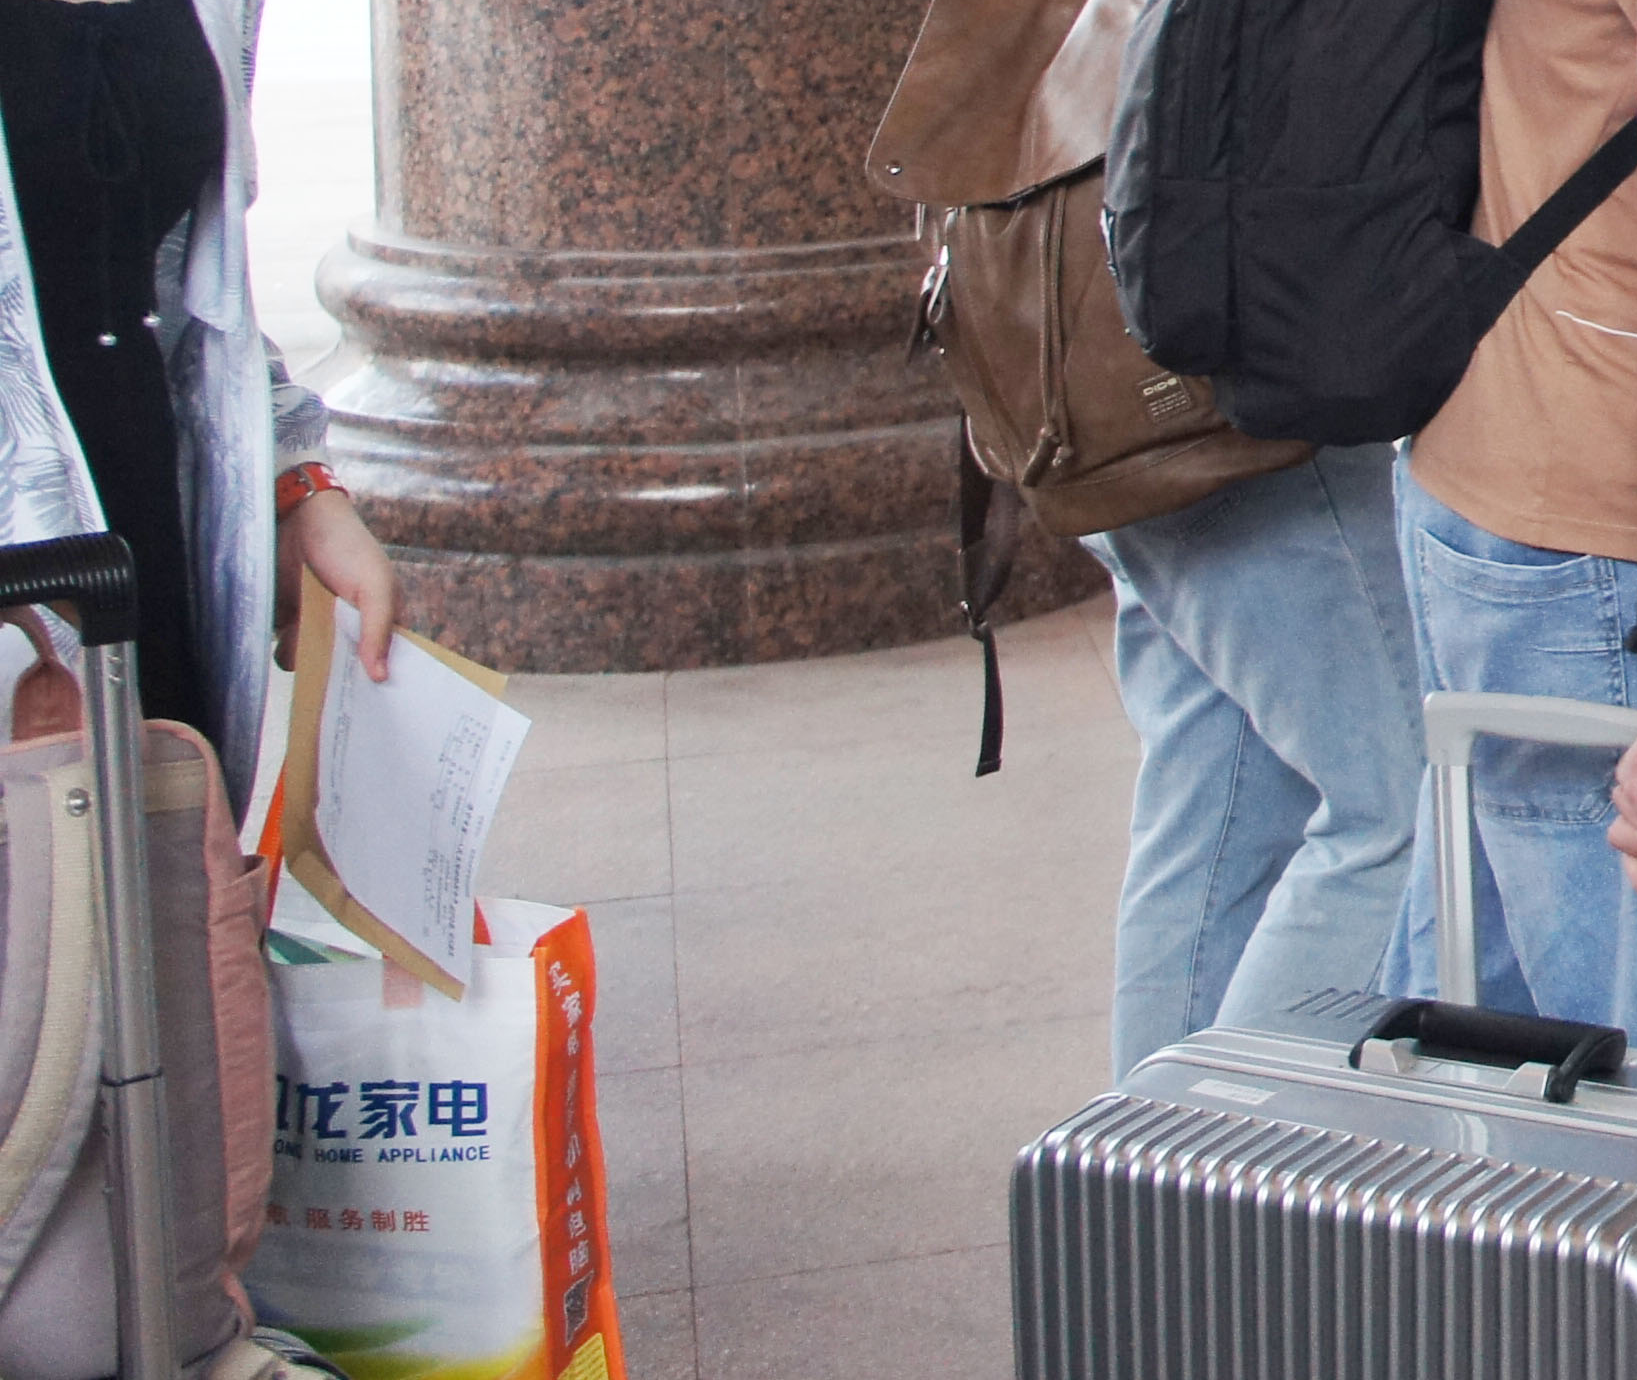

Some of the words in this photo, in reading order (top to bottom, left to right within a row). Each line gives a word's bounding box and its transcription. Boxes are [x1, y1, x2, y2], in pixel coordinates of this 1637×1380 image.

[275, 1073, 489, 1140] 龙家电
[314, 1147, 364, 1164] HOME
[377, 1145, 492, 1164] APPLIANCE
[305, 1203, 431, 1233] 服务制胜
